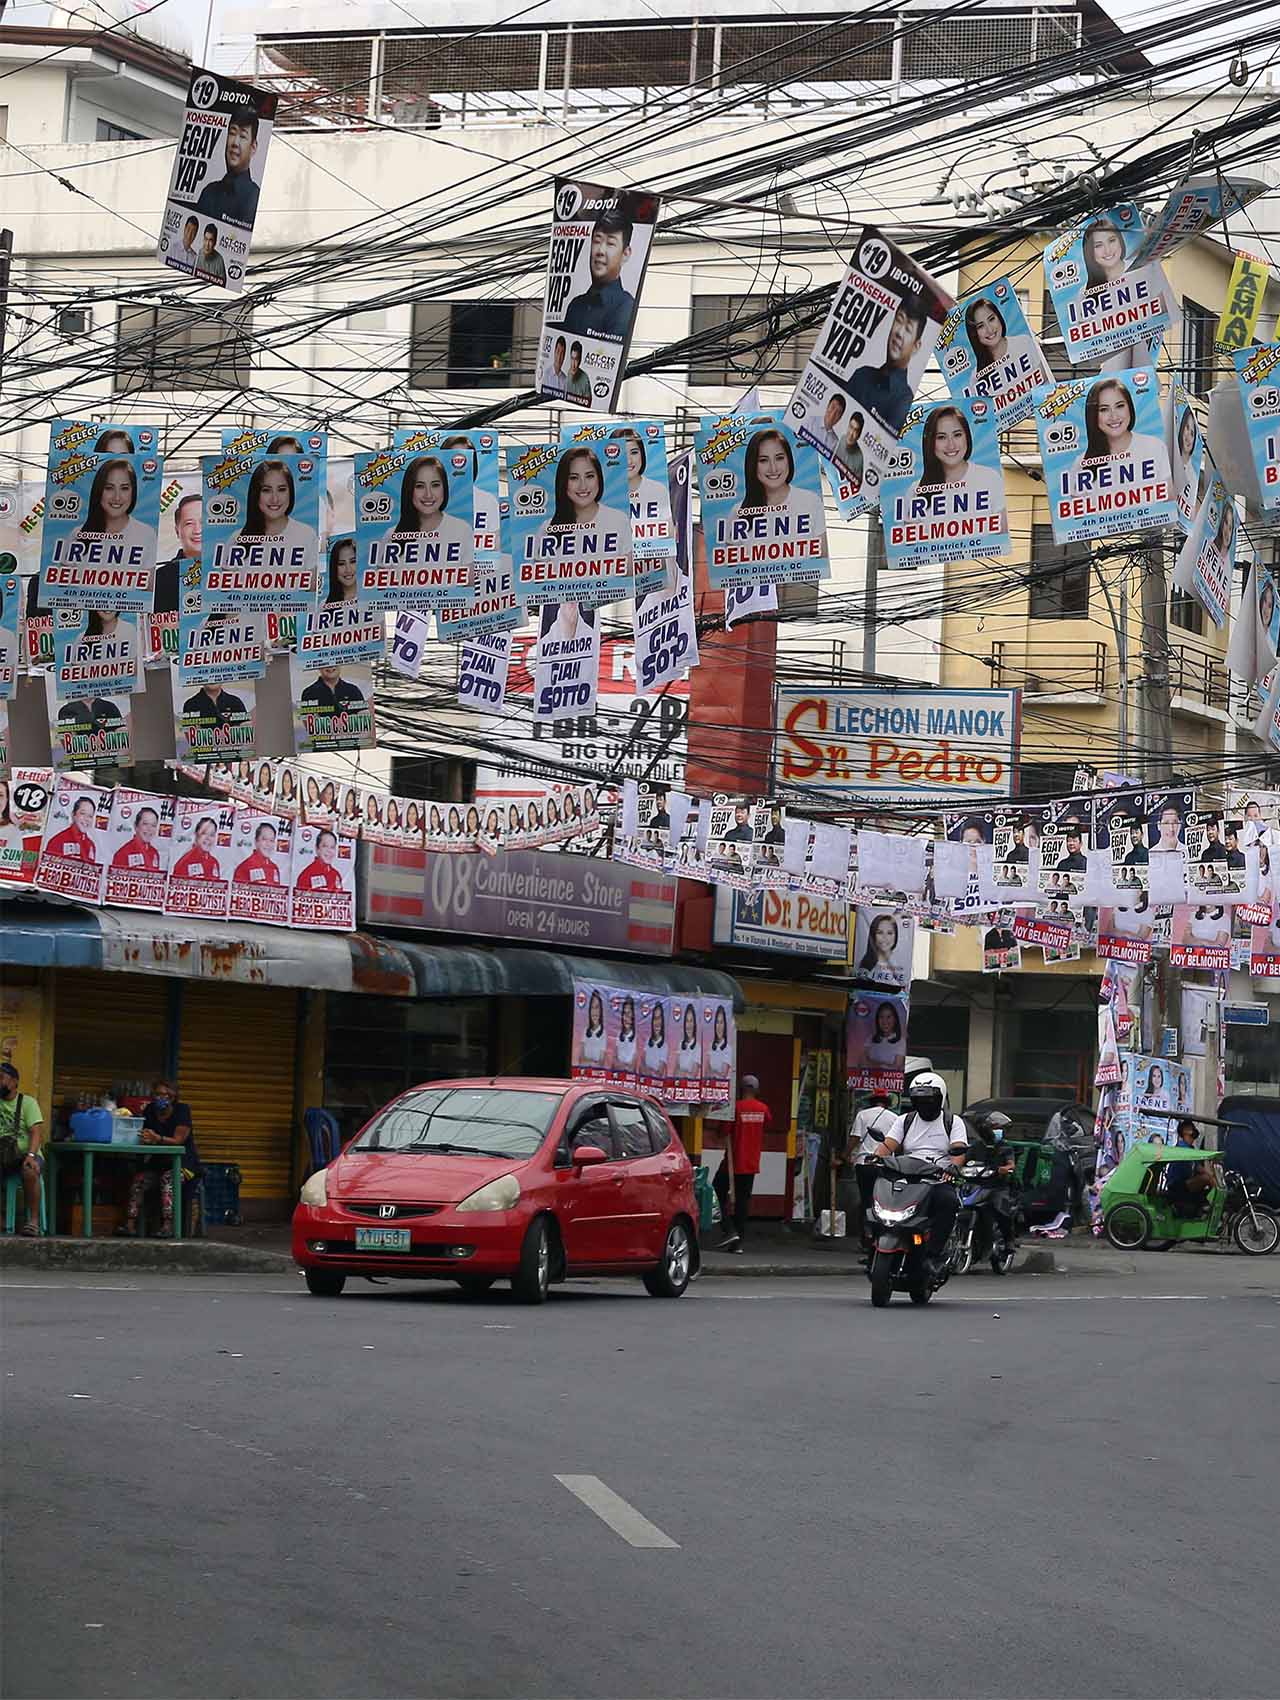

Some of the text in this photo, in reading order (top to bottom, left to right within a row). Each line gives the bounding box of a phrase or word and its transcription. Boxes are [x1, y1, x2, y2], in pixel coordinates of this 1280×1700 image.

[179, 125, 221, 161] EGAY
[175, 156, 207, 196] YAP
[51, 455, 98, 483] RE-ELECT
[77, 532, 123, 540] COUNCILOR
[53, 540, 143, 565] IRENE
[214, 544, 305, 567] IRENE
[46, 568, 148, 587] BELMONTE
[207, 571, 311, 590] BELMONTE
[543, 638, 592, 656] VICE MAYOR
[551, 661, 581, 685] GIAN
[538, 683, 590, 714] SOTTO
[835, 706, 1006, 737] LECHON MANOK
[561, 743, 597, 759] BIG
[782, 699, 1003, 784] Sr. Pedro
[1041, 839, 1064, 853] EGAY
[1042, 852, 1059, 868] YAP
[431, 855, 472, 916] 08
[475, 863, 575, 901] Convenience
[582, 872, 624, 908] Store
[508, 909, 591, 936] OPEN 24 HOURS
[797, 896, 847, 936] Pedro
[1252, 962, 1268, 975] JOY
